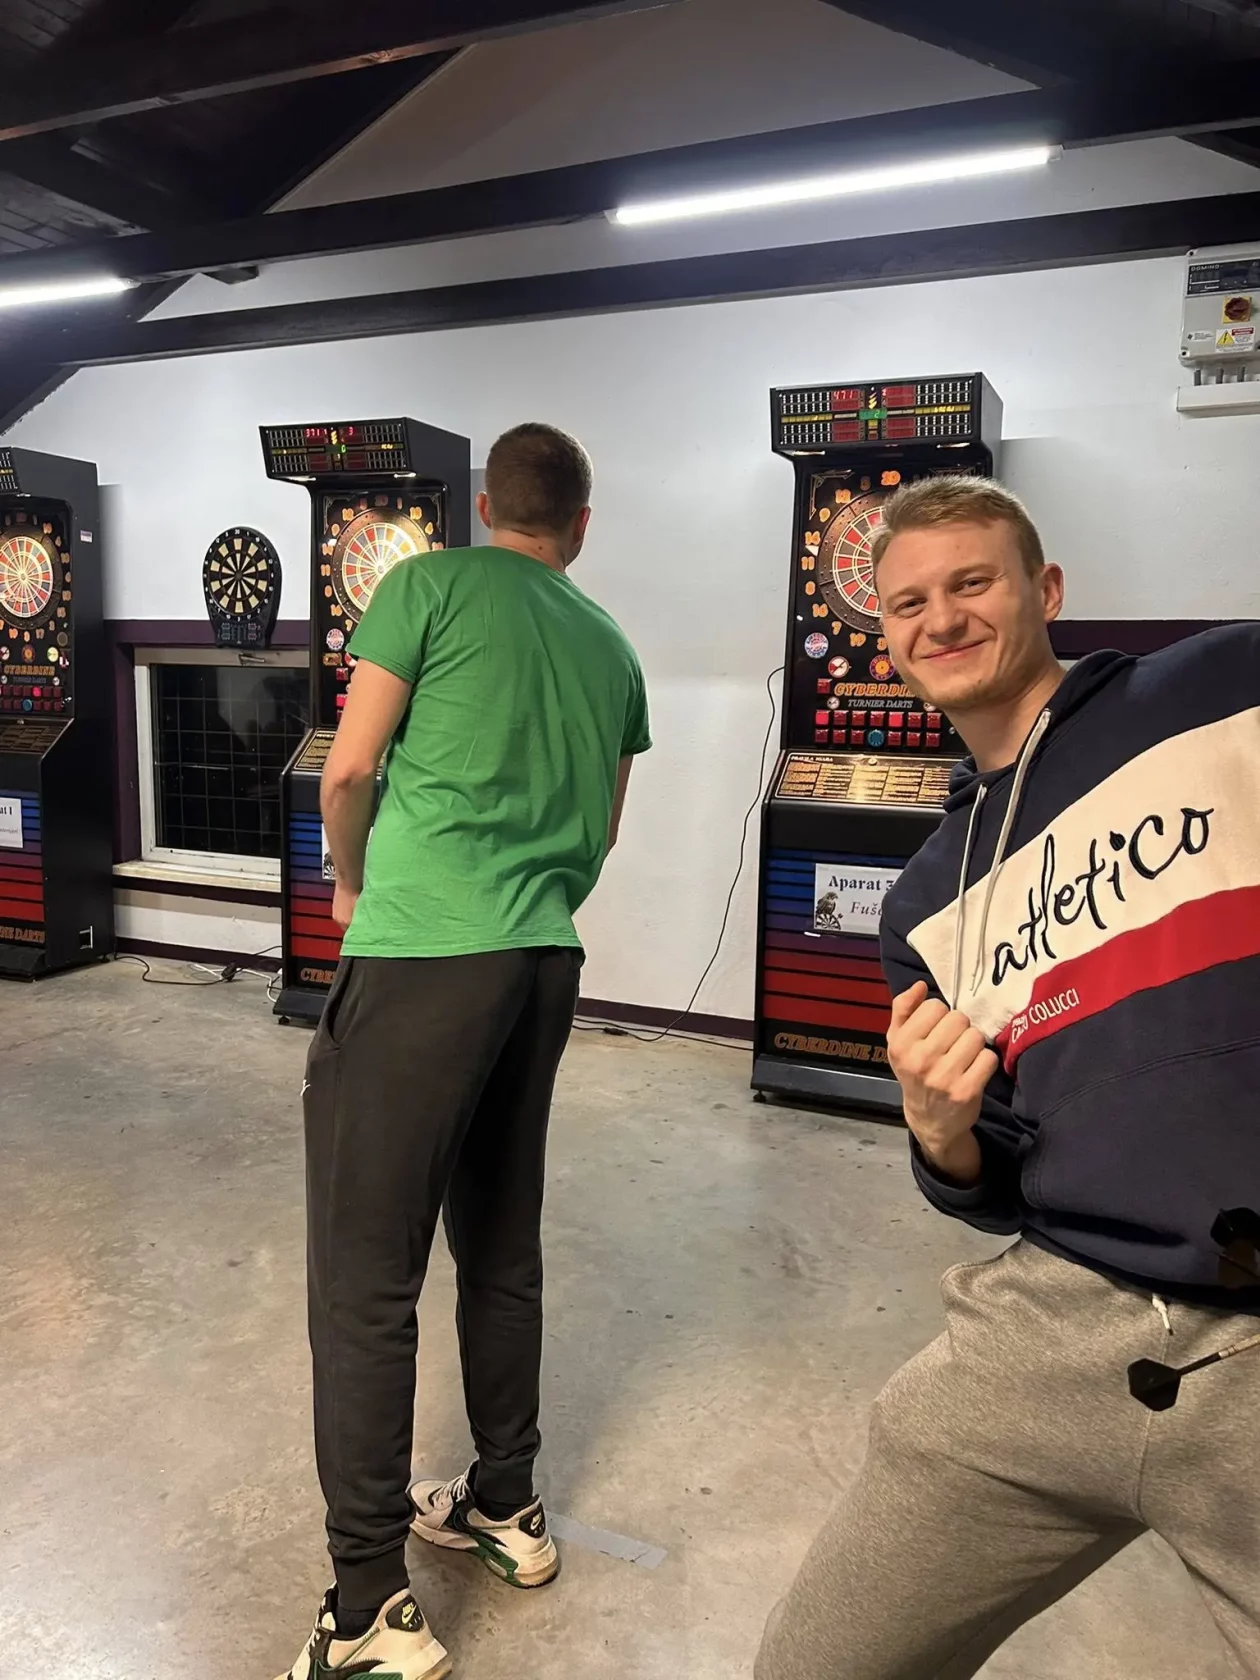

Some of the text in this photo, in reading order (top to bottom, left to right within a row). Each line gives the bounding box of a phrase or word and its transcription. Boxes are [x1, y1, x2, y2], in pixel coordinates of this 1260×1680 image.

[833, 682, 914, 697] CYBERDI
[847, 699, 914, 709] TURNIER DARTS
[829, 875, 882, 892] Aparat
[1029, 988, 1080, 1025] COLUCCI
[774, 1032, 872, 1061] CYBERDINE
